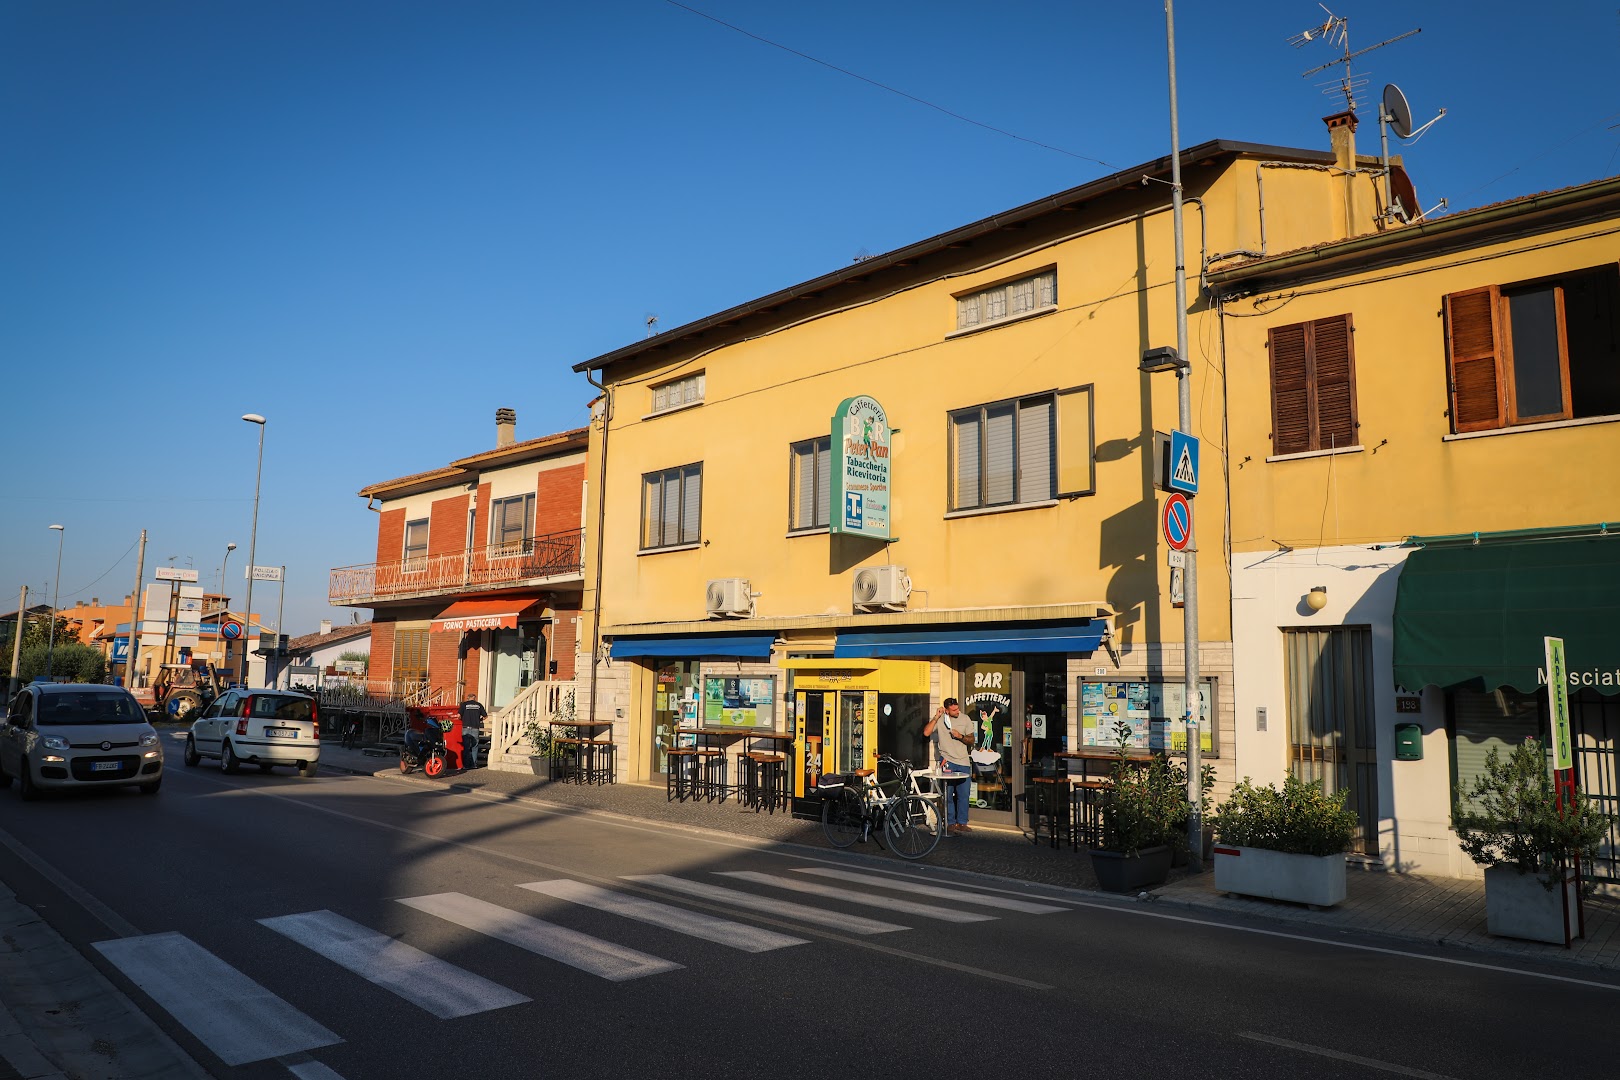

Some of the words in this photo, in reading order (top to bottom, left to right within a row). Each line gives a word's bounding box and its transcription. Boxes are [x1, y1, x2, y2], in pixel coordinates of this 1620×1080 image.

[850, 399, 885, 422] Caffetteria
[850, 415, 885, 443] BR
[844, 438, 868, 457] Peter
[870, 440, 889, 459] Pan
[846, 456, 887, 473] Tabaccheria
[846, 466, 886, 483] Ricevitoria
[443, 620, 464, 630] FORNO
[466, 617, 502, 629] PASTICCERIA
[974, 672, 1003, 689] BAR
[1537, 667, 1620, 686] Msciat
[965, 692, 1011, 707] CAFFETTERIA
[1401, 700, 1416, 710] 198
[1553, 647, 1567, 760] APERTO
[806, 752, 822, 767] 24
